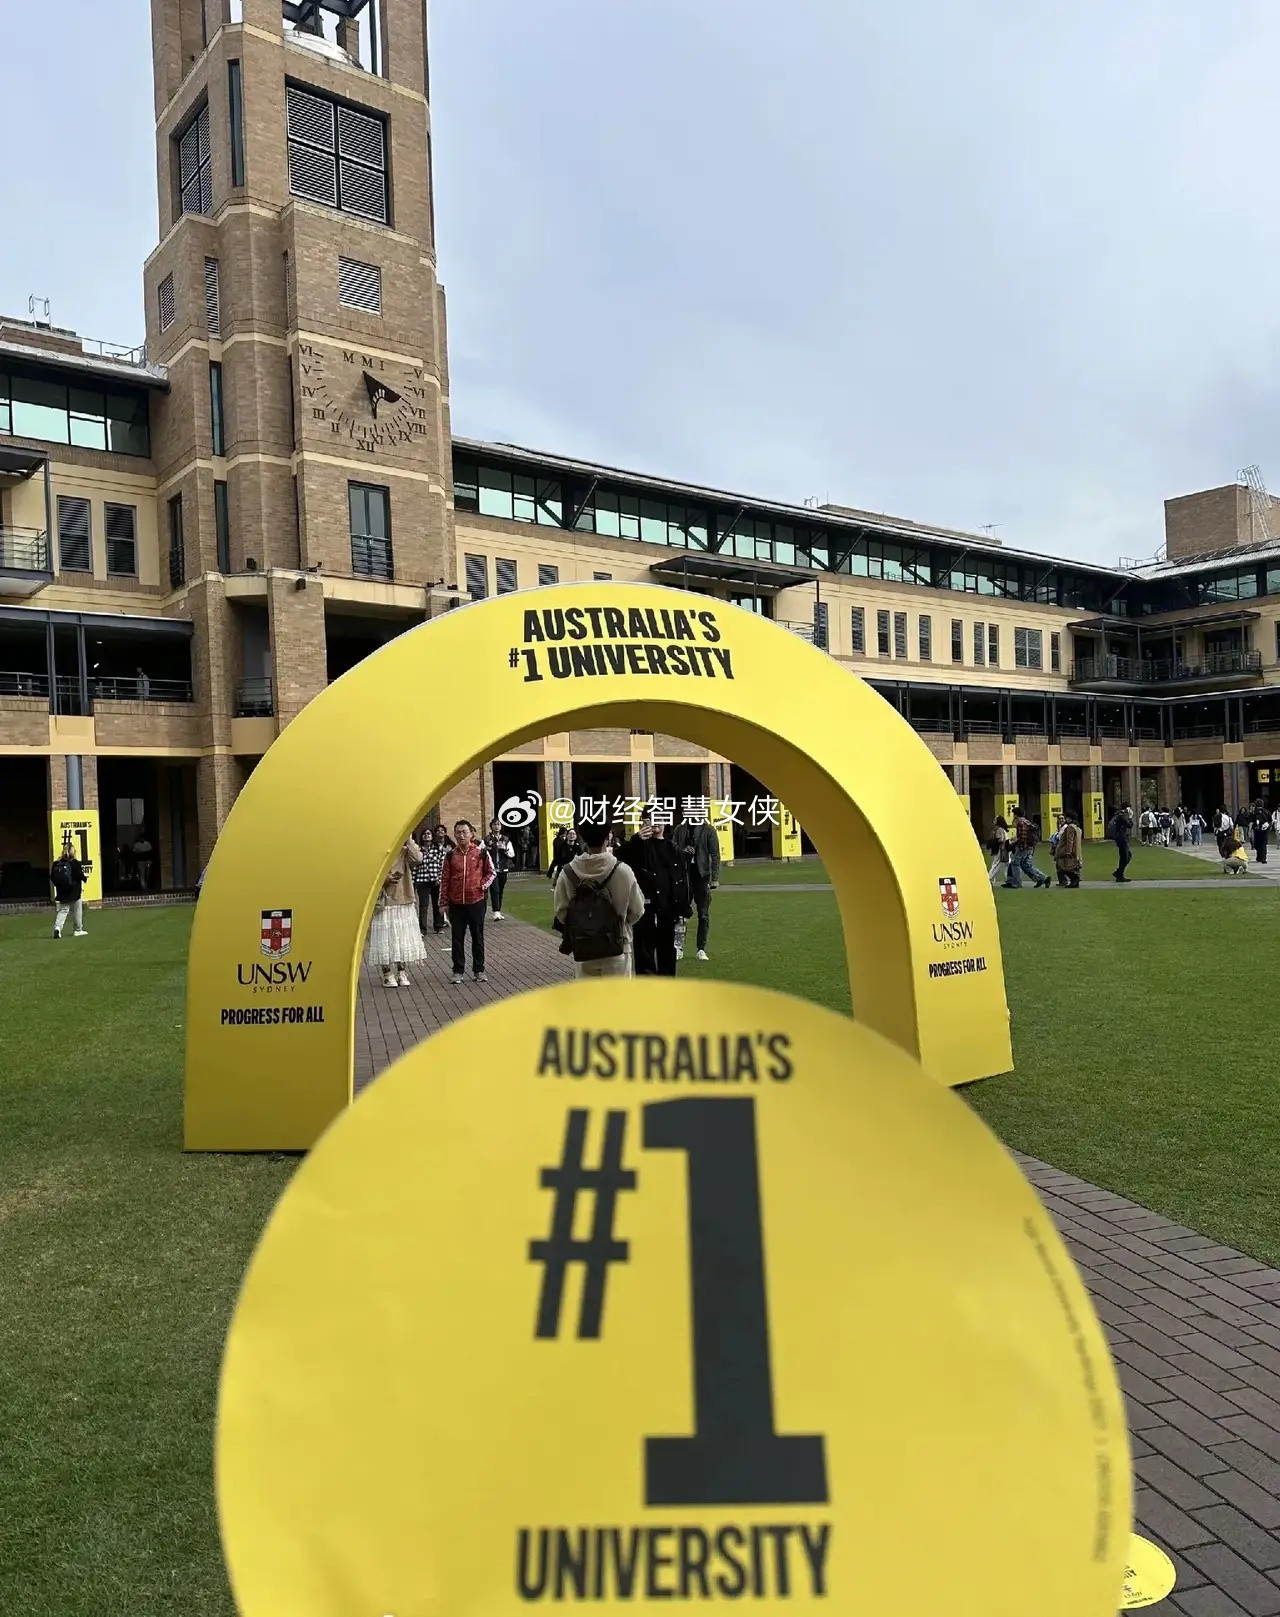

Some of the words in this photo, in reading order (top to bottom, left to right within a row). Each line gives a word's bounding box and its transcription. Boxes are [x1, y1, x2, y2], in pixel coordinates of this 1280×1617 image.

[312, 408, 326, 420] III
[331, 422, 340, 433] II
[523, 607, 721, 643] AUSTRALIA'S
[508, 648, 543, 682] #1
[548, 644, 735, 680] UNIVERSITY
[932, 921, 974, 943] UNSW
[237, 961, 313, 985] UNSW
[928, 960, 963, 979] PROGRESS
[963, 958, 975, 973] FOR
[976, 957, 987, 971] ALL
[252, 985, 296, 993] SYDNEY
[221, 1008, 280, 1025] PROGRESS
[282, 1007, 304, 1024] FOR
[306, 1006, 324, 1023] ALL
[536, 1026, 794, 1083] AUSTRALIA'S
[527, 1095, 832, 1508] #1
[514, 1522, 833, 1603] UNIVERSITY
